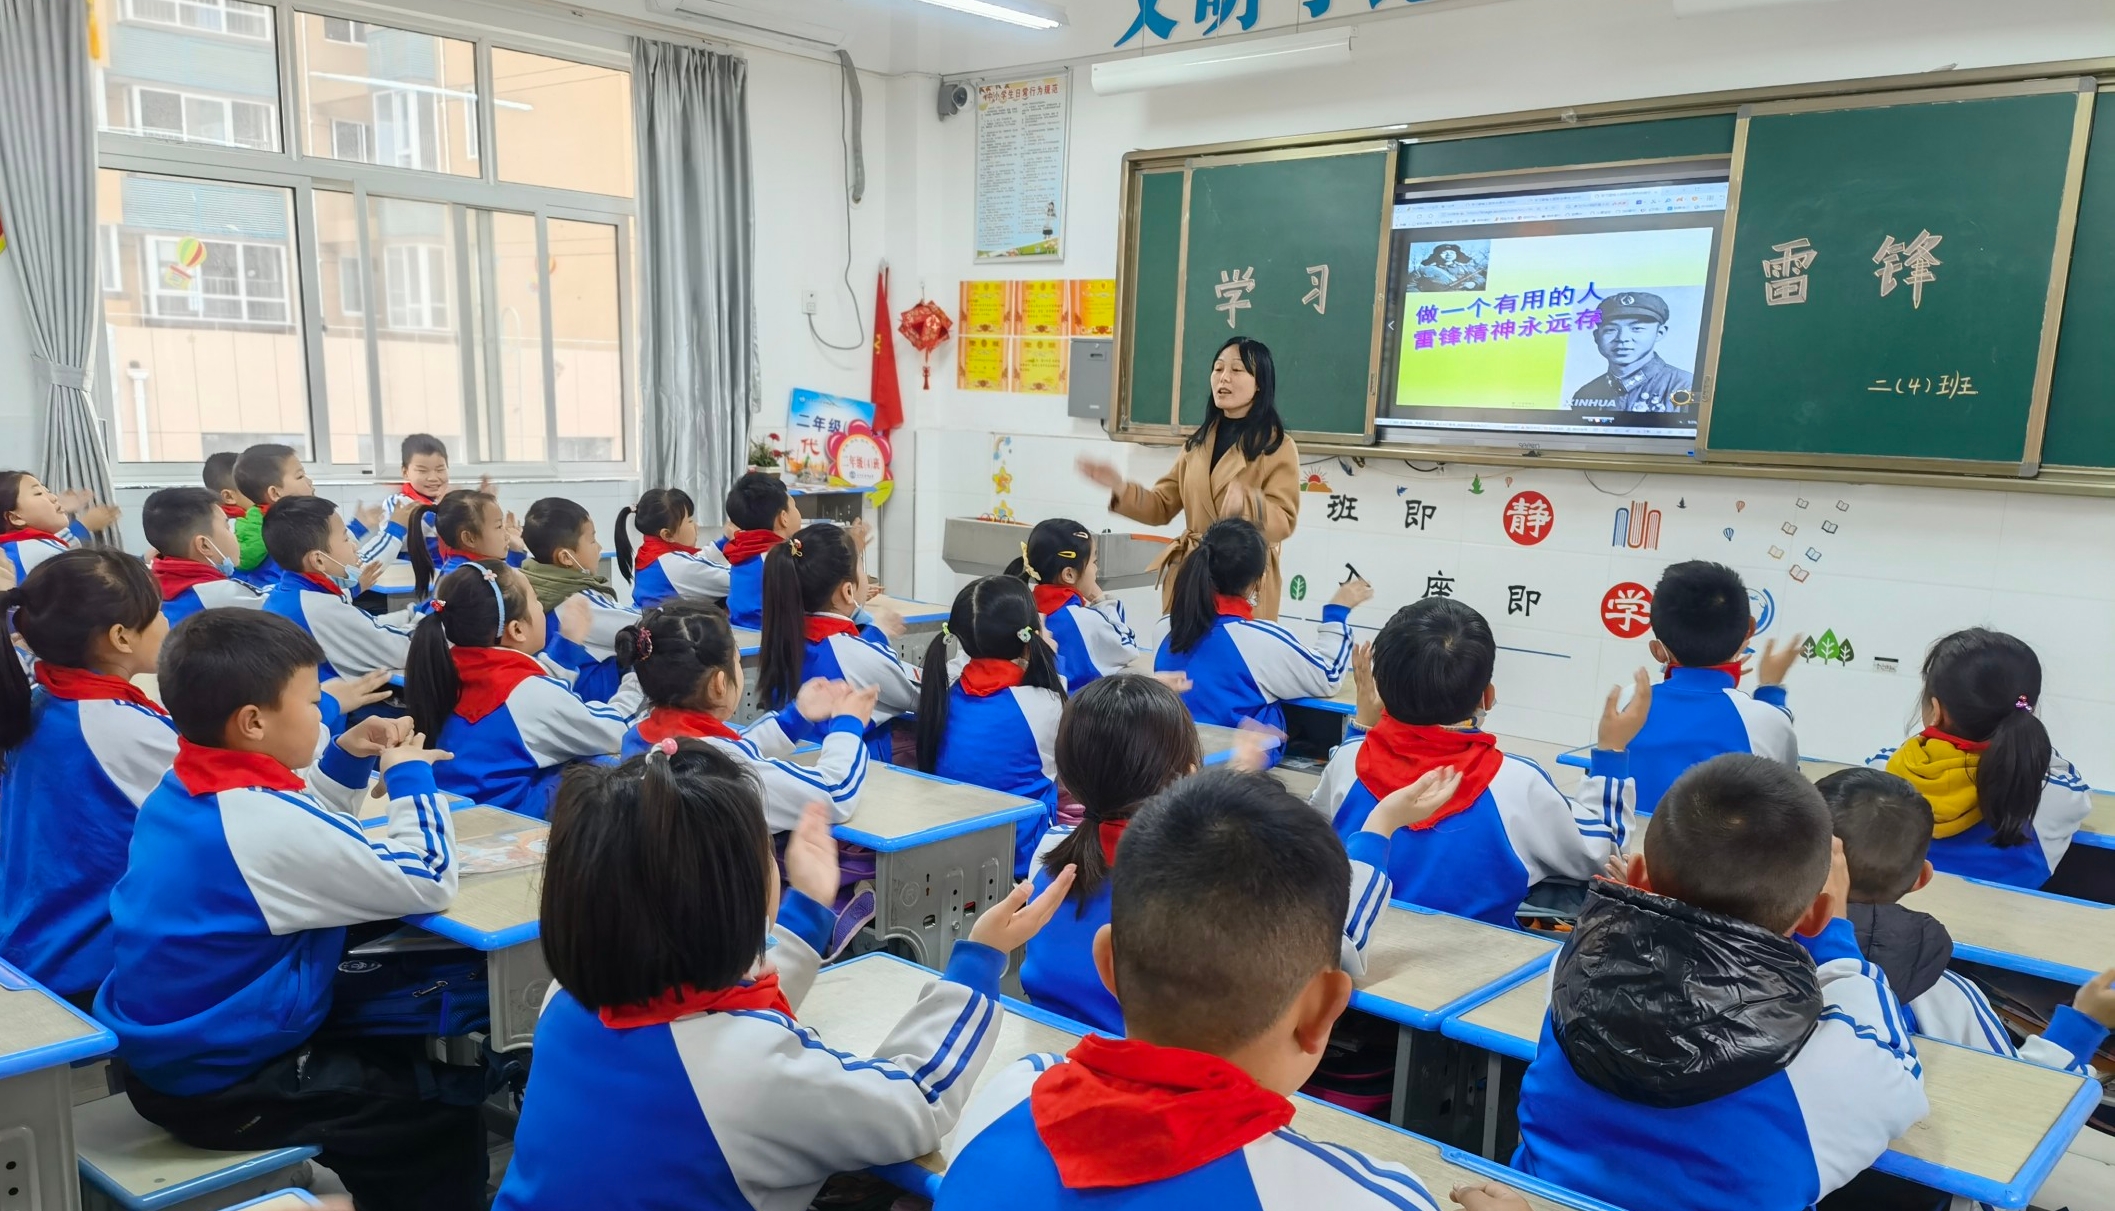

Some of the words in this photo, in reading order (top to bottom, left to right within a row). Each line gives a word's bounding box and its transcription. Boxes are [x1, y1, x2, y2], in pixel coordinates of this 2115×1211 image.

[1762, 229, 1943, 309] 雷锋
[1214, 264, 1330, 329] 学习
[1415, 281, 1605, 325] 做一个有用的人
[1413, 307, 1603, 350] 雷锋精神永远存
